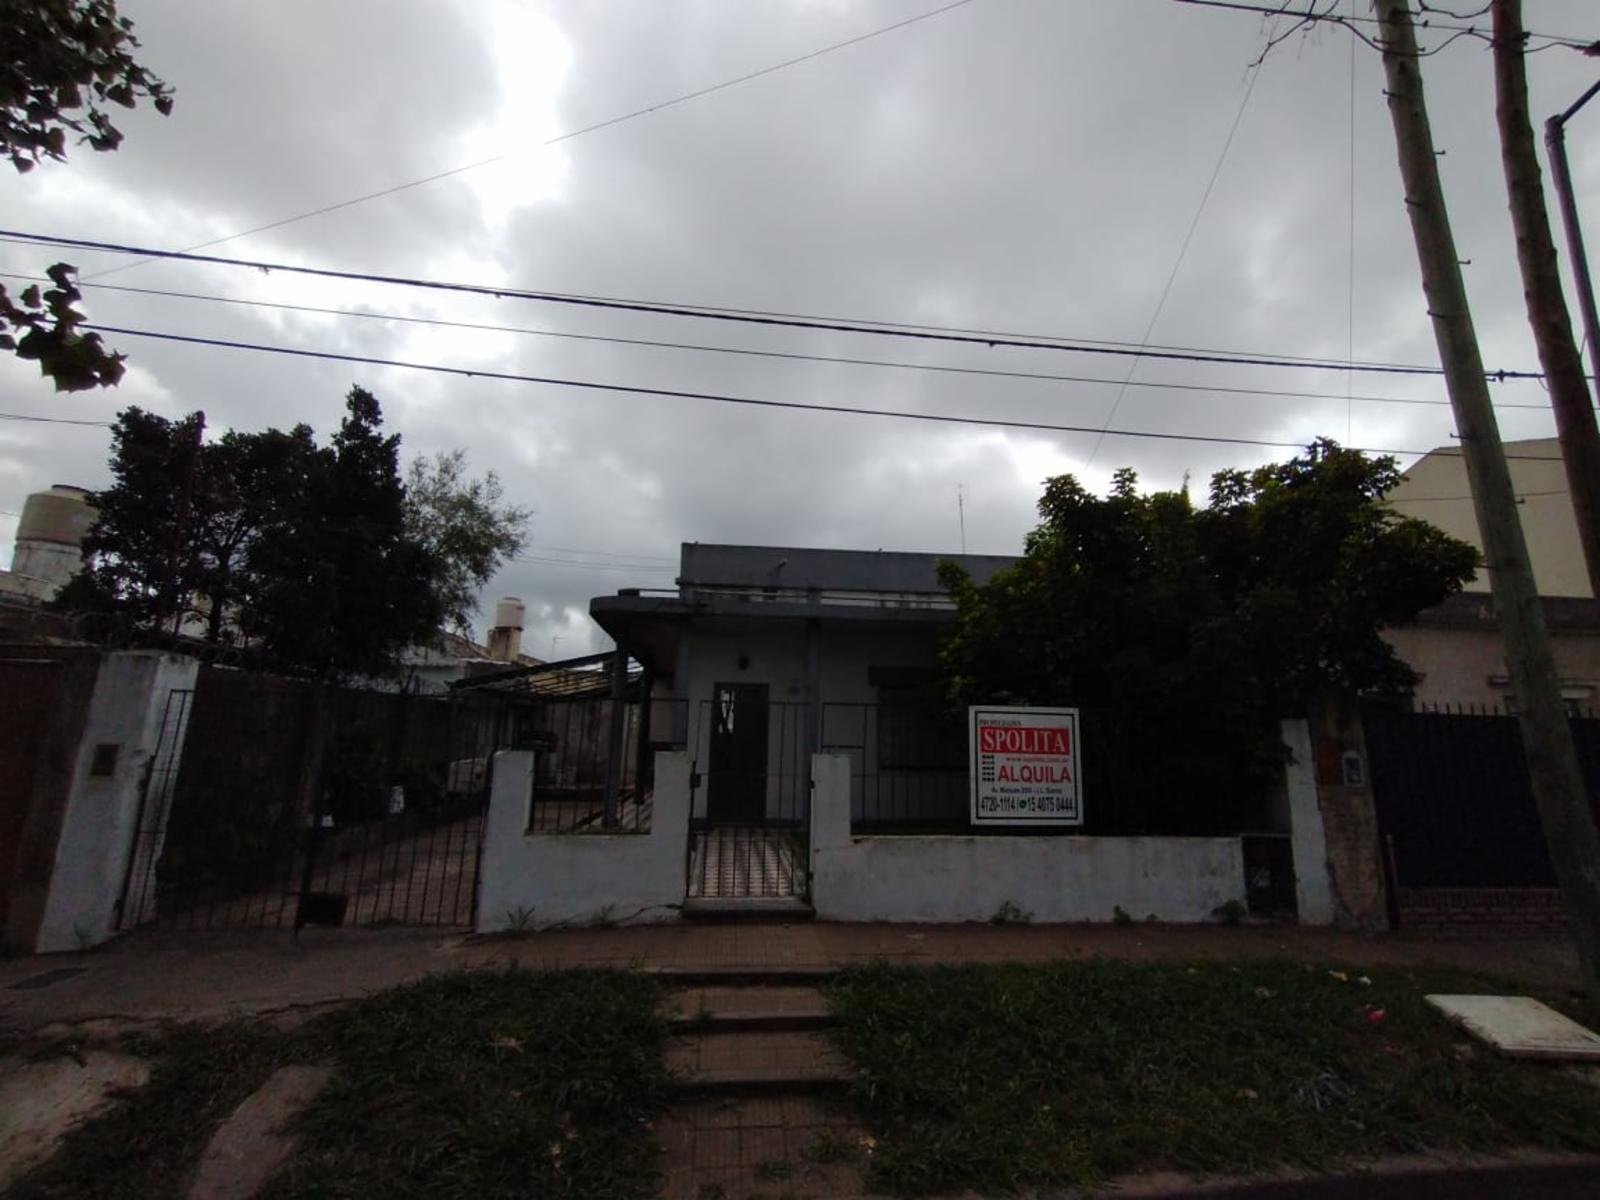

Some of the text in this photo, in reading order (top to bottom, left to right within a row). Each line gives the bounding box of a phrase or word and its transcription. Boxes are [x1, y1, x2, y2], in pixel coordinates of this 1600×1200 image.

[983, 728, 1066, 752] SPOLITA
[998, 766, 1072, 784] ALQUILA
[981, 796, 1015, 812] 4720-1114
[1027, 796, 1036, 812] 15
